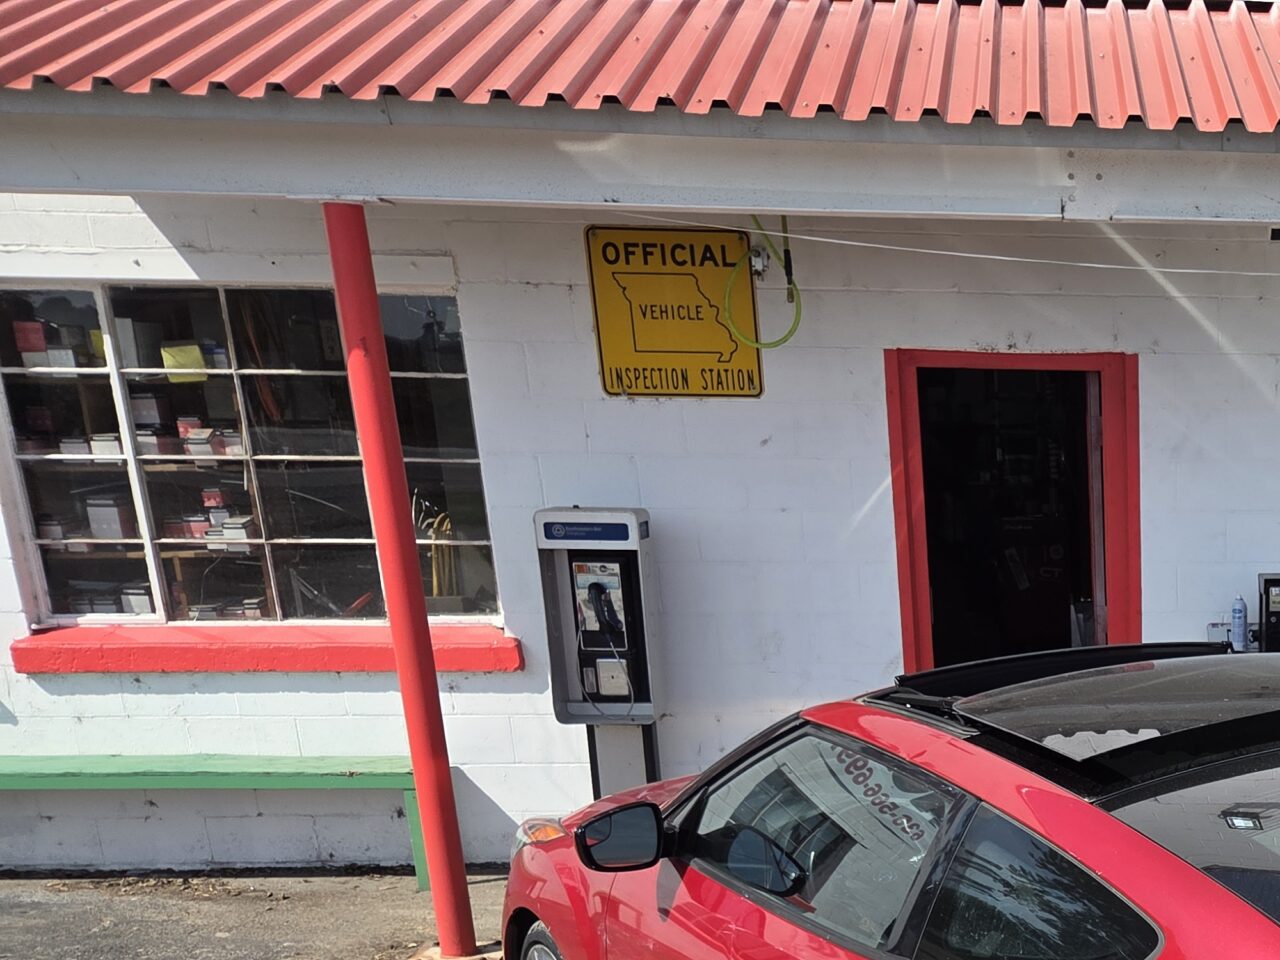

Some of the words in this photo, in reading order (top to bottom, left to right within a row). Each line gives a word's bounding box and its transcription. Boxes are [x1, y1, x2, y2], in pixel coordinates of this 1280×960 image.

[601, 241, 738, 268] OFFICIAL
[639, 303, 705, 321] VEHICLE
[608, 367, 690, 391] INSPECTION
[700, 367, 756, 391] STATION
